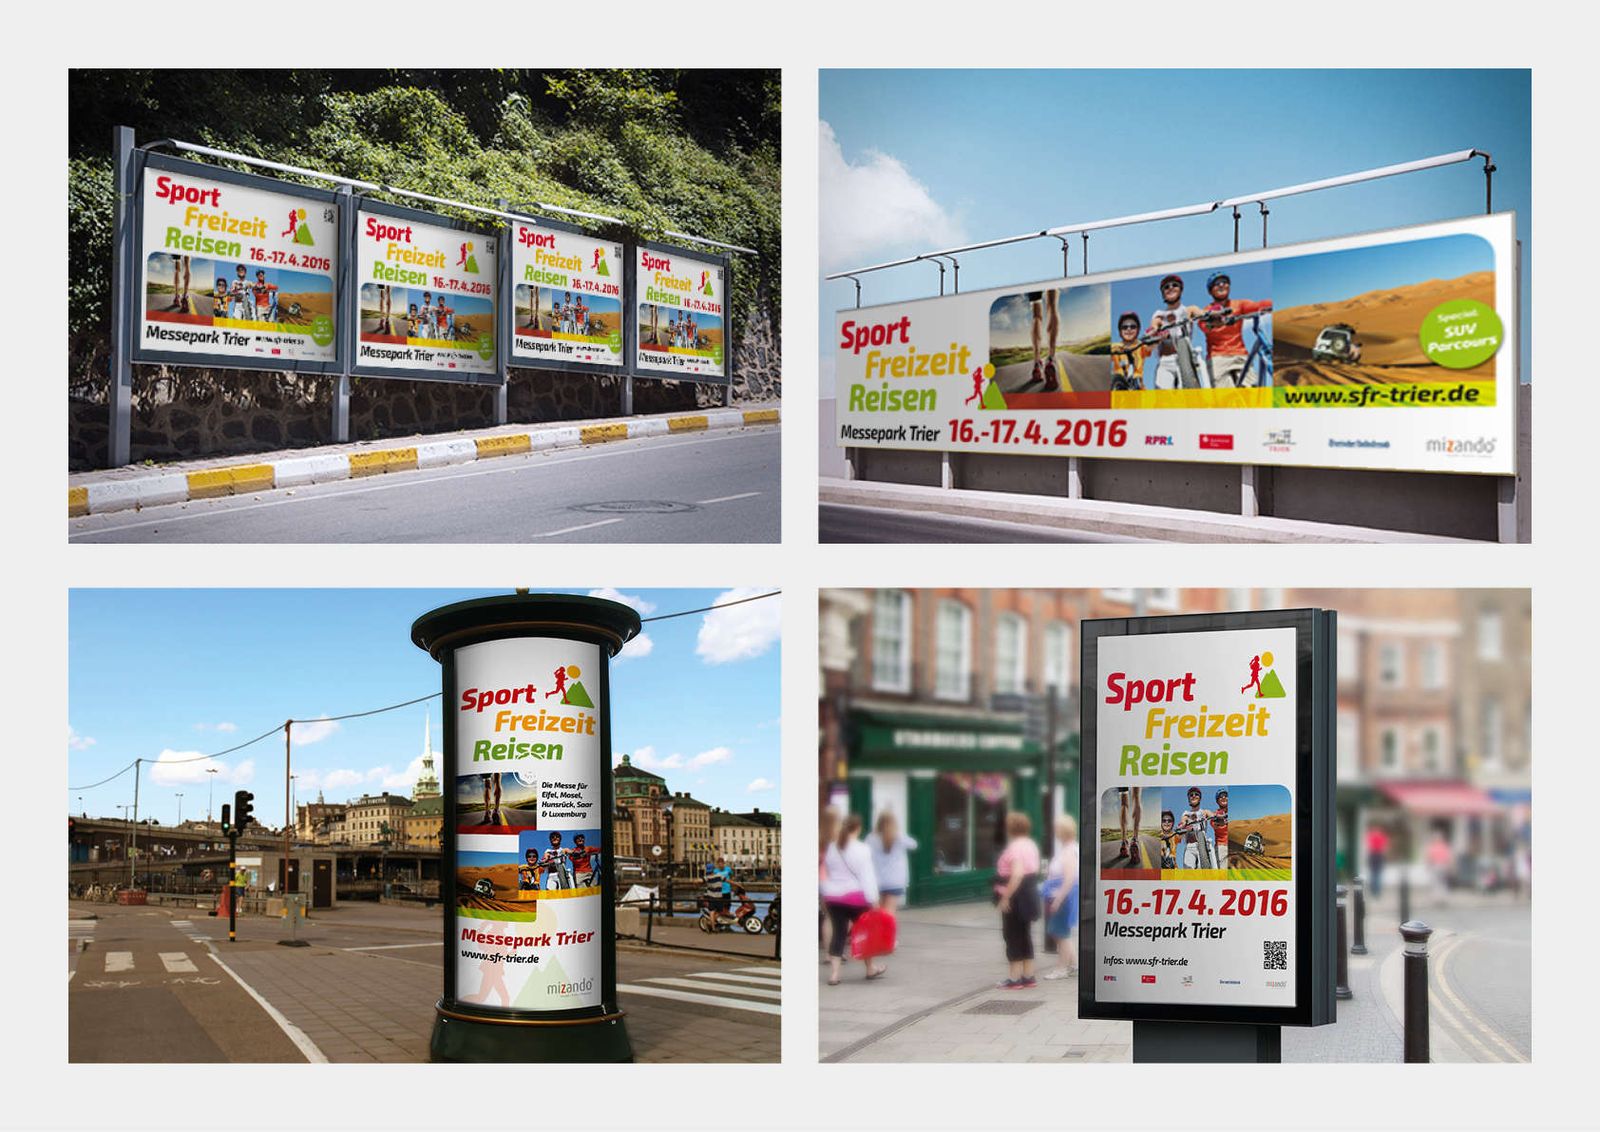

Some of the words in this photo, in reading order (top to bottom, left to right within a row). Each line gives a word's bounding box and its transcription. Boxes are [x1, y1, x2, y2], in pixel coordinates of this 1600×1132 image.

[156, 176, 221, 207] Sport
[184, 206, 268, 239] Freizeit
[366, 217, 412, 243] Sport
[165, 227, 241, 257] Reisen
[518, 227, 556, 249] Sport
[302, 255, 330, 271] 2016
[386, 242, 447, 269] Freizeit
[535, 249, 582, 272] Freizeit
[641, 251, 670, 272] Sport
[373, 261, 427, 286] Reisen
[524, 264, 568, 286] Reisen
[654, 271, 692, 292] Freizeit
[471, 282, 491, 295] 2016
[646, 285, 680, 305] Reisen
[1437, 309, 1478, 323] Special
[146, 325, 220, 346] Messepark
[222, 331, 250, 347] Trier
[840, 316, 911, 355] Sport
[1444, 322, 1477, 338] SUV
[360, 345, 413, 361] Messepark
[414, 349, 435, 361] Trier
[515, 338, 557, 353] Messepark
[558, 342, 574, 354] Trier
[1427, 336, 1497, 354] Parcours
[865, 342, 971, 379] Freizeit
[848, 381, 937, 412] Reisen
[1284, 384, 1480, 407] www.sfr-trier.de
[841, 424, 906, 443] Messepark
[909, 425, 941, 442] Trier
[1054, 419, 1128, 447] 2016
[1425, 436, 1492, 454] mizando
[460, 684, 537, 712] Sport
[1105, 672, 1196, 711] Sport
[495, 709, 597, 736] Freizeit
[1145, 703, 1271, 739] Freizeit
[473, 737, 564, 762] Reisen
[1119, 743, 1229, 776] Reisen
[541, 781, 553, 789] Die
[554, 781, 576, 789] Messe
[577, 781, 588, 790] für
[541, 791, 559, 800] Eifel,
[560, 791, 583, 800] Mosel,
[541, 800, 576, 809] Hunsrück,
[541, 810, 547, 818] &
[549, 810, 587, 819] Luxemburg
[1219, 889, 1288, 917] 2016
[461, 928, 551, 949] Messepark
[556, 930, 595, 946] Trier
[1103, 921, 1188, 942] Messepark
[1192, 922, 1227, 939] Trier
[461, 950, 540, 964] www.sfr-trier.de
[1103, 956, 1124, 967] Infos:
[1125, 956, 1189, 967] www.sfr-trier.de
[547, 978, 593, 995] mizando
